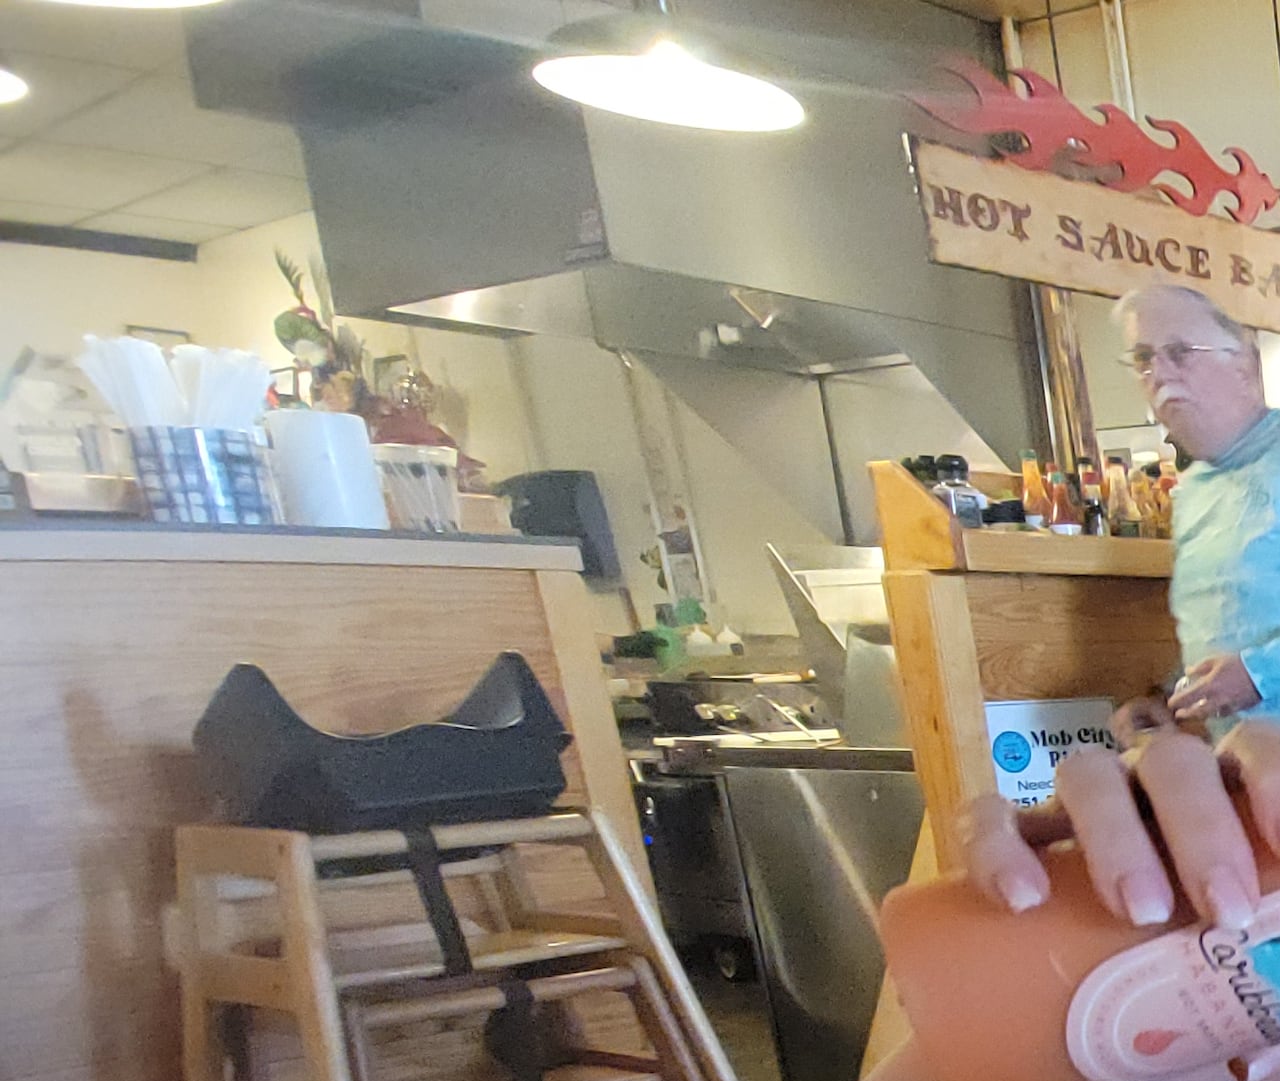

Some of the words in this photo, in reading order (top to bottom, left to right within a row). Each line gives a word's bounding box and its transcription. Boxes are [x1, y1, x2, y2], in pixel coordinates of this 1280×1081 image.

[927, 184, 1032, 242] HOT
[1056, 214, 1212, 280] SAUCE
[1030, 729, 1073, 748] Mob
[1077, 727, 1119, 751] City
